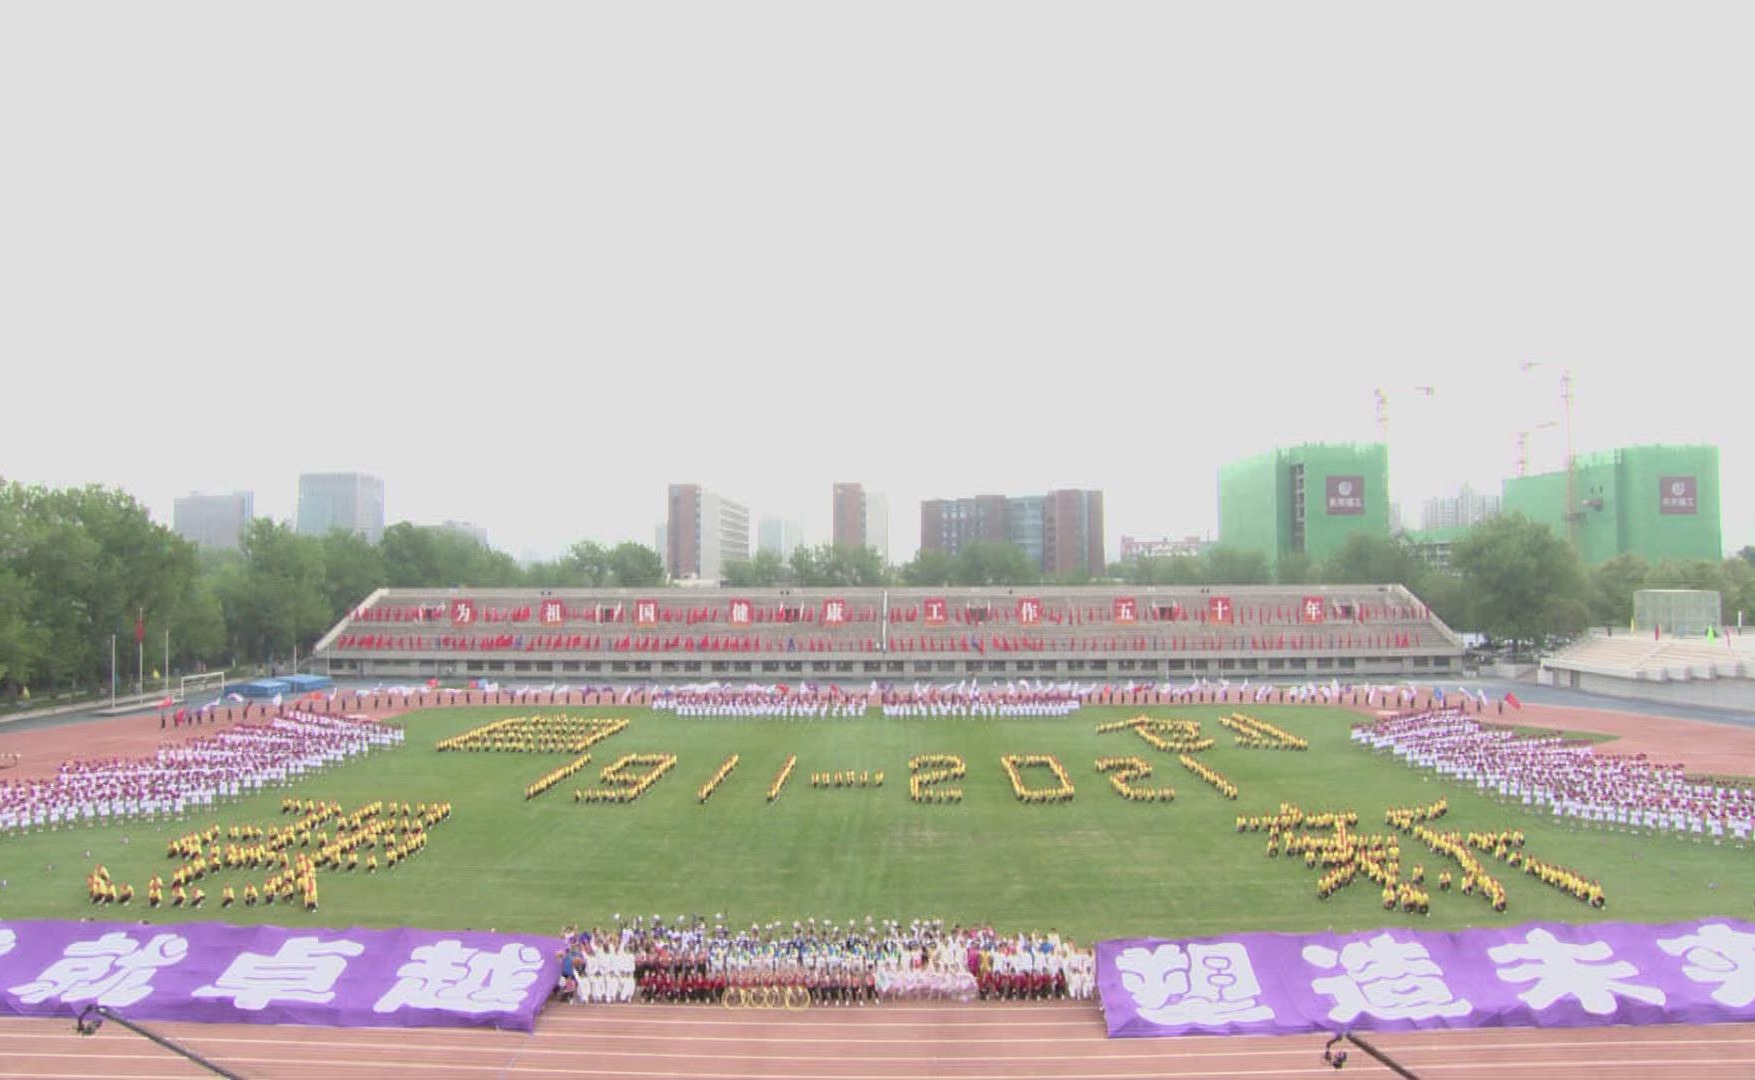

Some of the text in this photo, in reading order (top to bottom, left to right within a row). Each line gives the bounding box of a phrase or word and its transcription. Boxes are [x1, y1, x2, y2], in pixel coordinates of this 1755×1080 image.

[455, 600, 1322, 624] 为祖国健康工作五十年
[0, 929, 545, 1013] 就卓越
